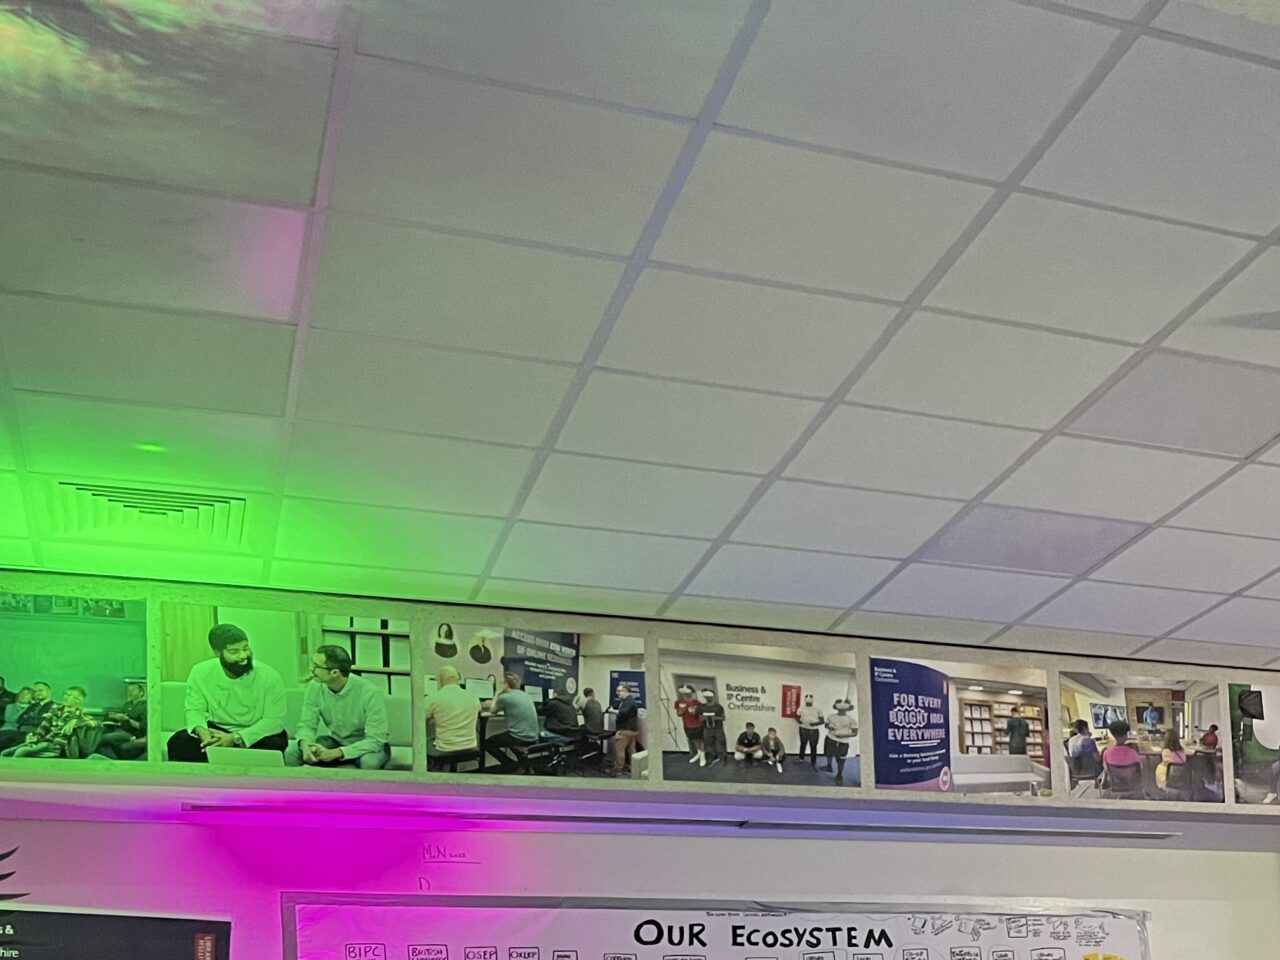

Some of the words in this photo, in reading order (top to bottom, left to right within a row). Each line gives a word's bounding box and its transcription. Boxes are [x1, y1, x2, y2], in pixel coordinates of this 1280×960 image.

[726, 684, 759, 693] Business
[735, 694, 760, 702] Centre
[893, 693, 915, 706] FOR
[918, 695, 942, 708] EVERY
[728, 702, 776, 712] Oxfordshire
[889, 710, 928, 724] BRIGHT
[888, 728, 946, 740] EVERYWHERE
[5, 924, 14, 935] &
[634, 919, 707, 947] OUR
[731, 925, 893, 948] ECOSYSTEM
[348, 946, 382, 959] BIPC
[411, 948, 443, 957] BRITISH
[466, 950, 497, 960] OSEP
